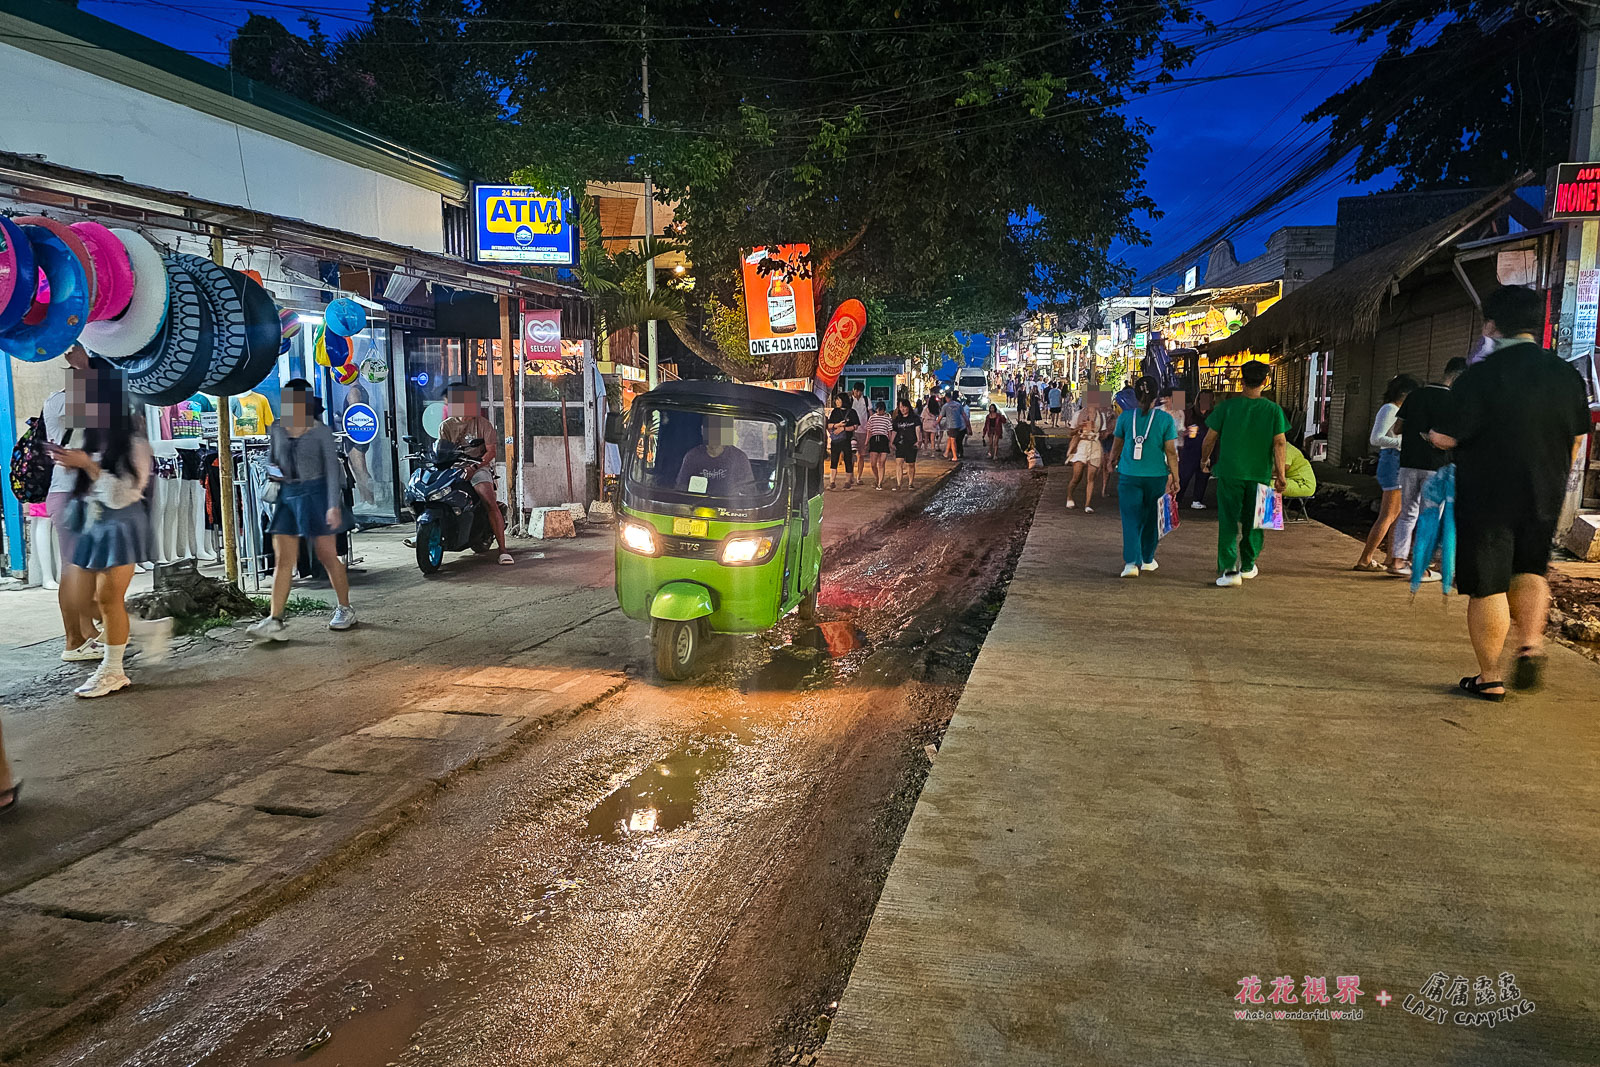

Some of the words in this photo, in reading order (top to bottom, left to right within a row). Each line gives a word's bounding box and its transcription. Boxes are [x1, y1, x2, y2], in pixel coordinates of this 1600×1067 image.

[501, 189, 511, 197] 24
[511, 189, 528, 197] hour
[490, 199, 557, 222] ATM
[530, 345, 556, 353] SELECTA
[751, 340, 771, 354] ONE
[771, 339, 779, 352] 4
[780, 338, 793, 351] DA
[793, 336, 817, 351] ROAD
[827, 340, 845, 359] HORSE
[833, 336, 846, 350] RED
[680, 541, 700, 551] TVS
